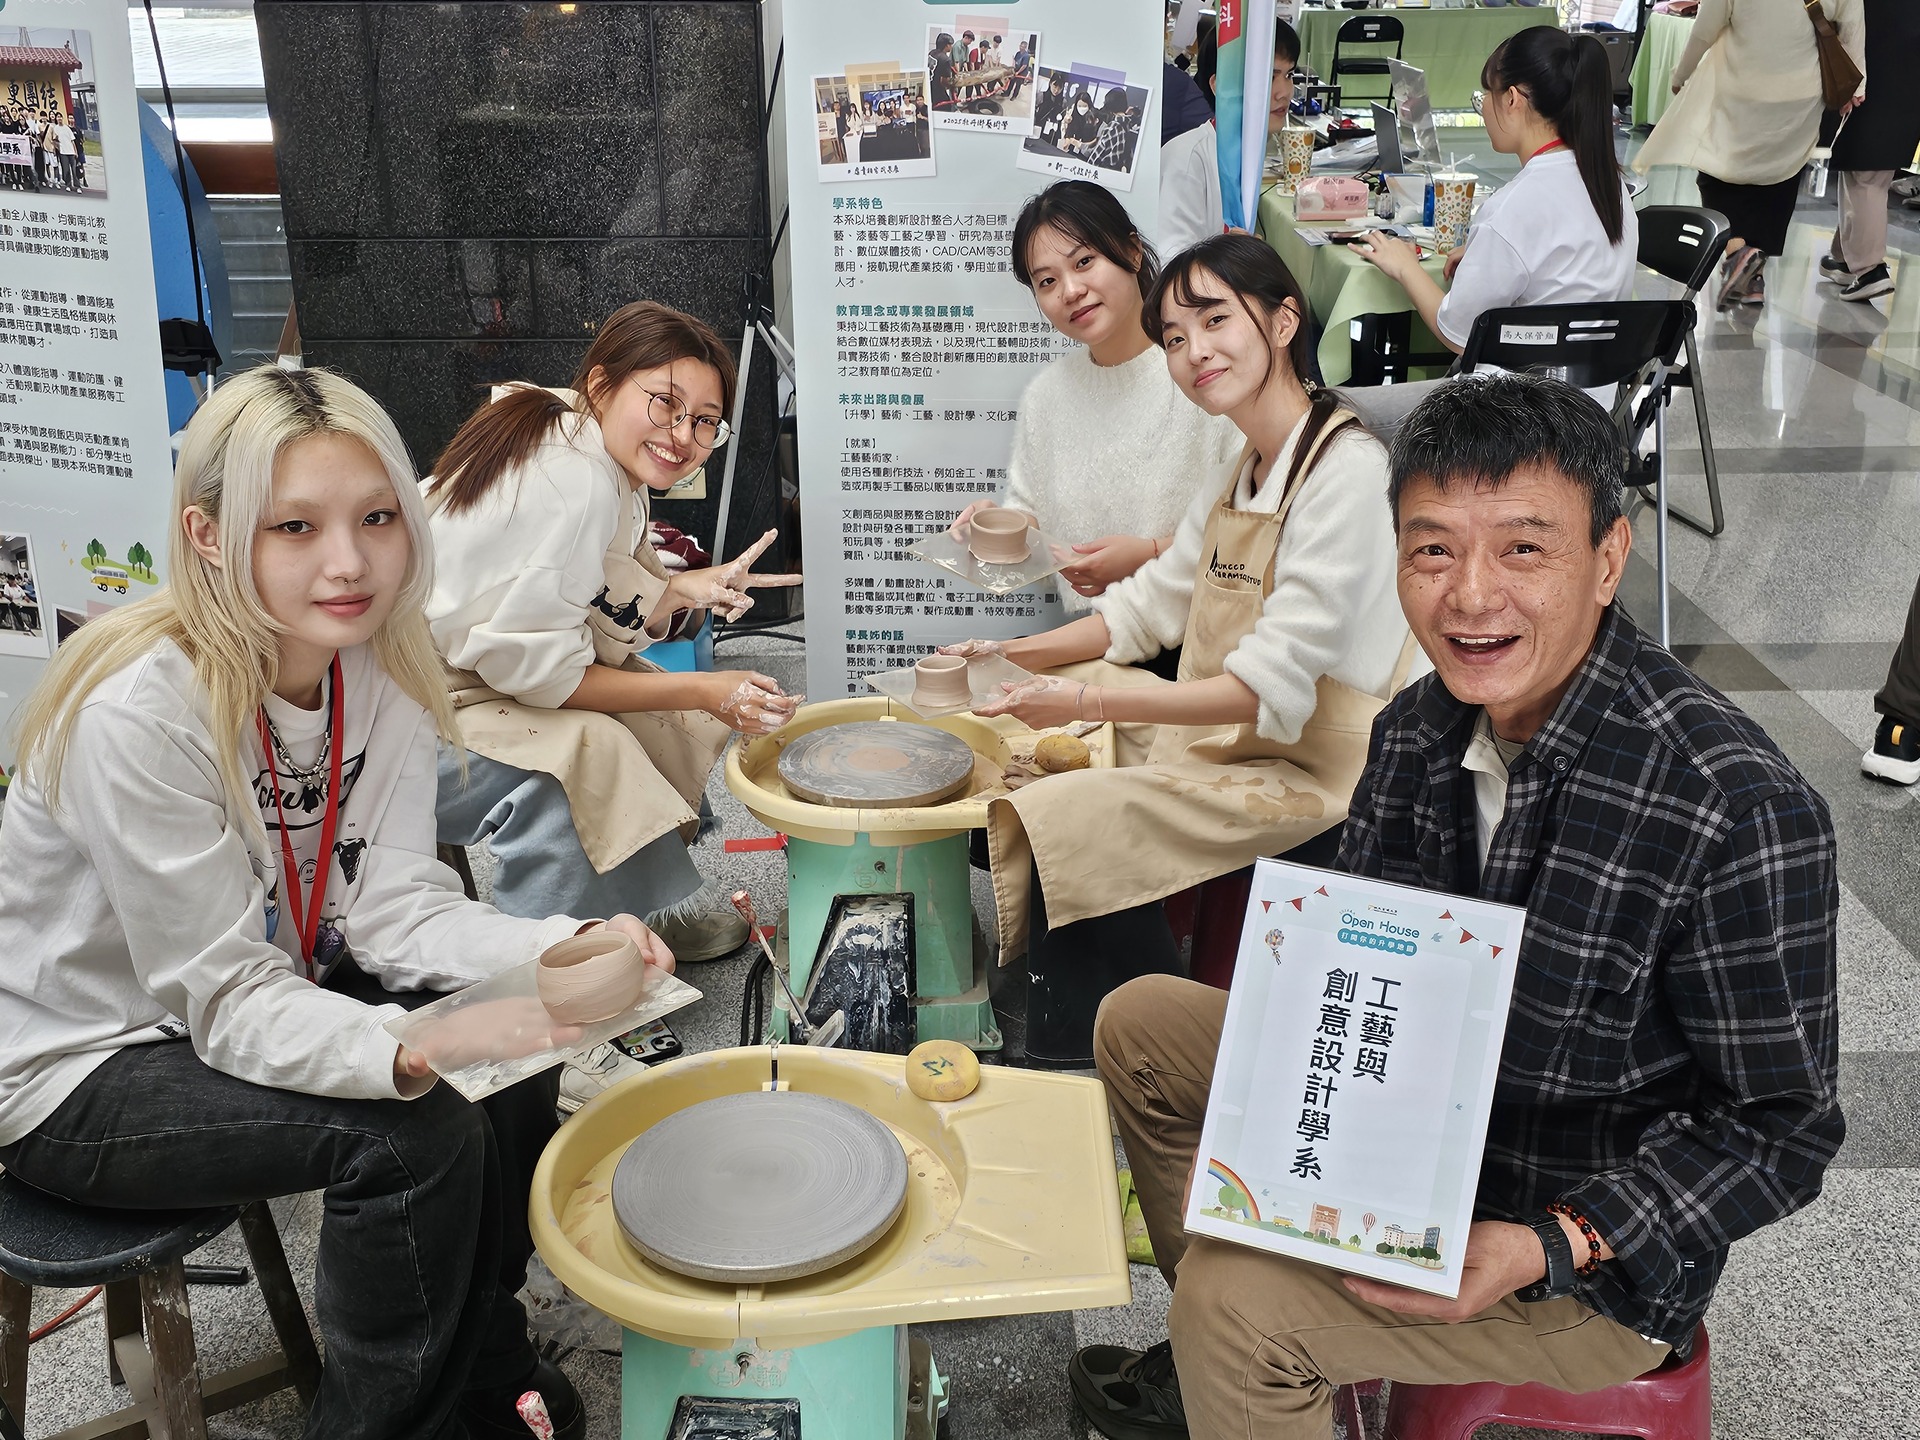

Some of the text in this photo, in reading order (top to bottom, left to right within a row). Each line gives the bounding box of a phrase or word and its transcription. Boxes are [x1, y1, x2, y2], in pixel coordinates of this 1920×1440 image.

[0, 142, 21, 155] 學系
[832, 197, 883, 210] 學系特色
[835, 276, 864, 288] 人才。
[836, 305, 975, 318] 教育理念或專業發展領域
[837, 351, 1070, 364] 具實務技術，整合設計創新應用的創意設計與工
[837, 366, 941, 378] 才之教育單位為定位。
[839, 393, 925, 406] 未來出路與發展
[844, 438, 877, 449] 【就業】
[840, 452, 900, 463] 工藝藝術家：
[845, 629, 904, 641] 學長姊的話
[846, 643, 939, 656] 藝創系不僅提供堅實
[846, 657, 920, 669] 務技術，鼓勵參
[1341, 913, 1420, 938] Open House
[1352, 975, 1402, 1084] 工藝與
[1289, 966, 1359, 1181] 創意設計學系
